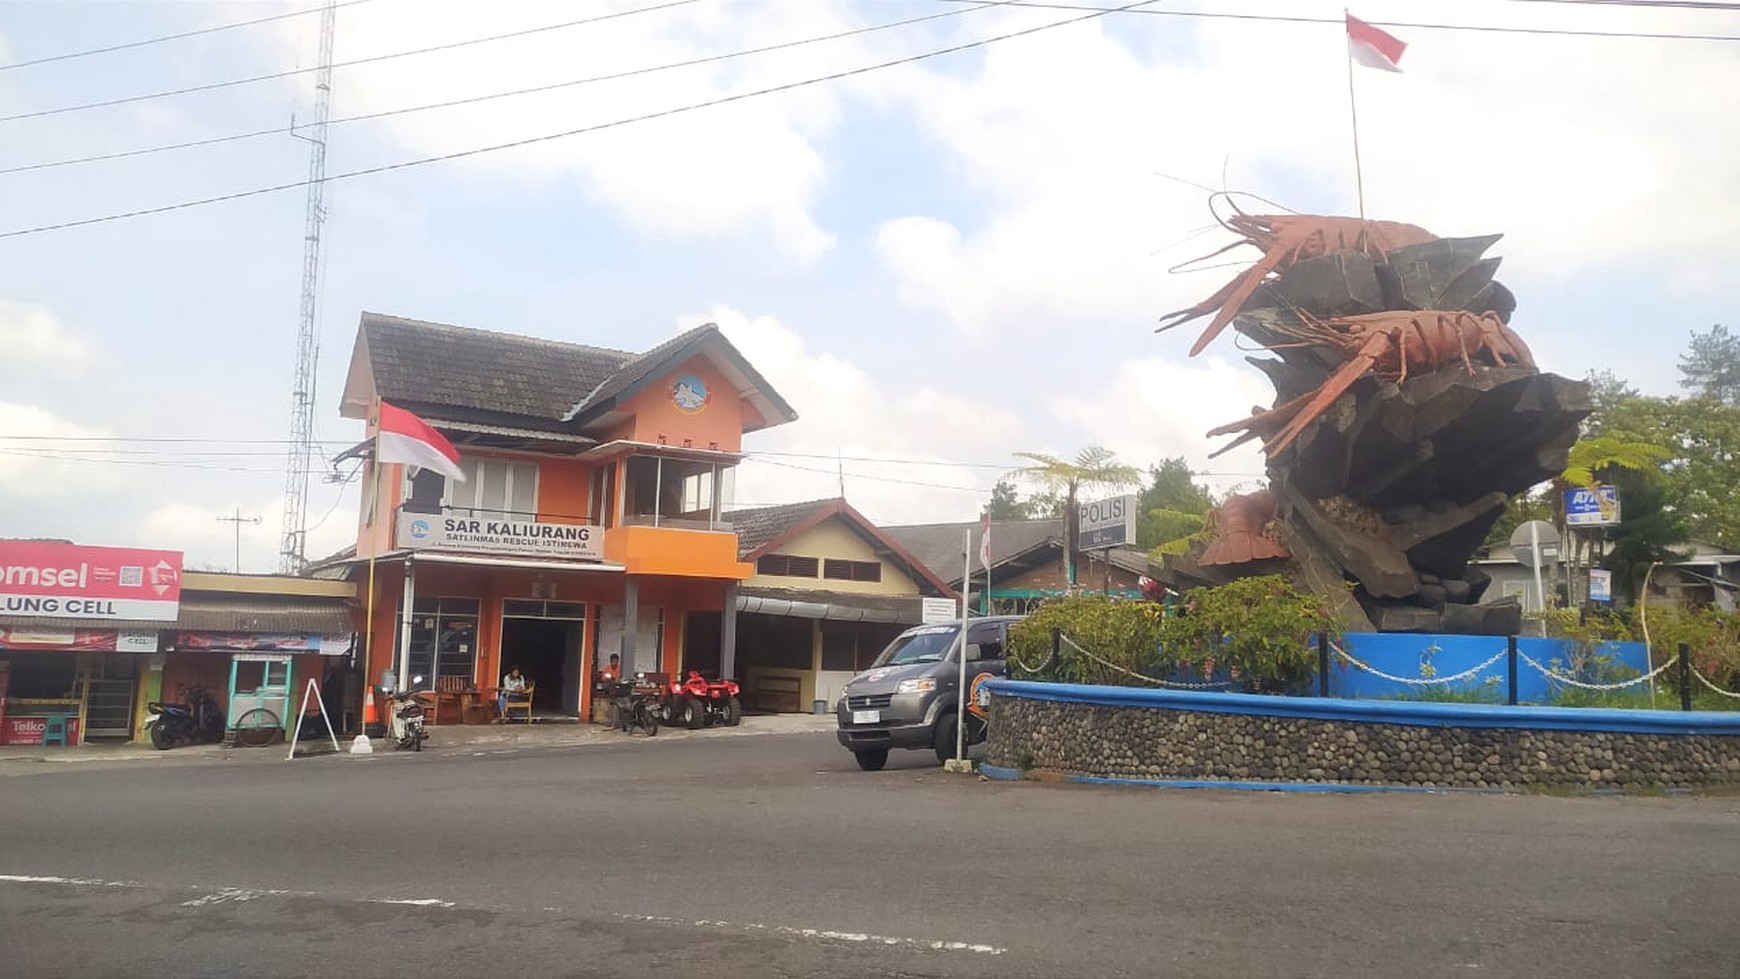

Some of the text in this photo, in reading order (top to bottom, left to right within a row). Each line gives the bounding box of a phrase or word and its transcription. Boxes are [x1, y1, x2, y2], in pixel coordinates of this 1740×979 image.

[1080, 496, 1126, 524] POLISI
[445, 519, 589, 541] SAR KALIURANG
[446, 533, 500, 544] SATLINMAS
[503, 537, 540, 547] RESCUE
[542, 540, 587, 549] ISTIMEWA
[0, 562, 88, 588] msel
[65, 600, 116, 615] CELL
